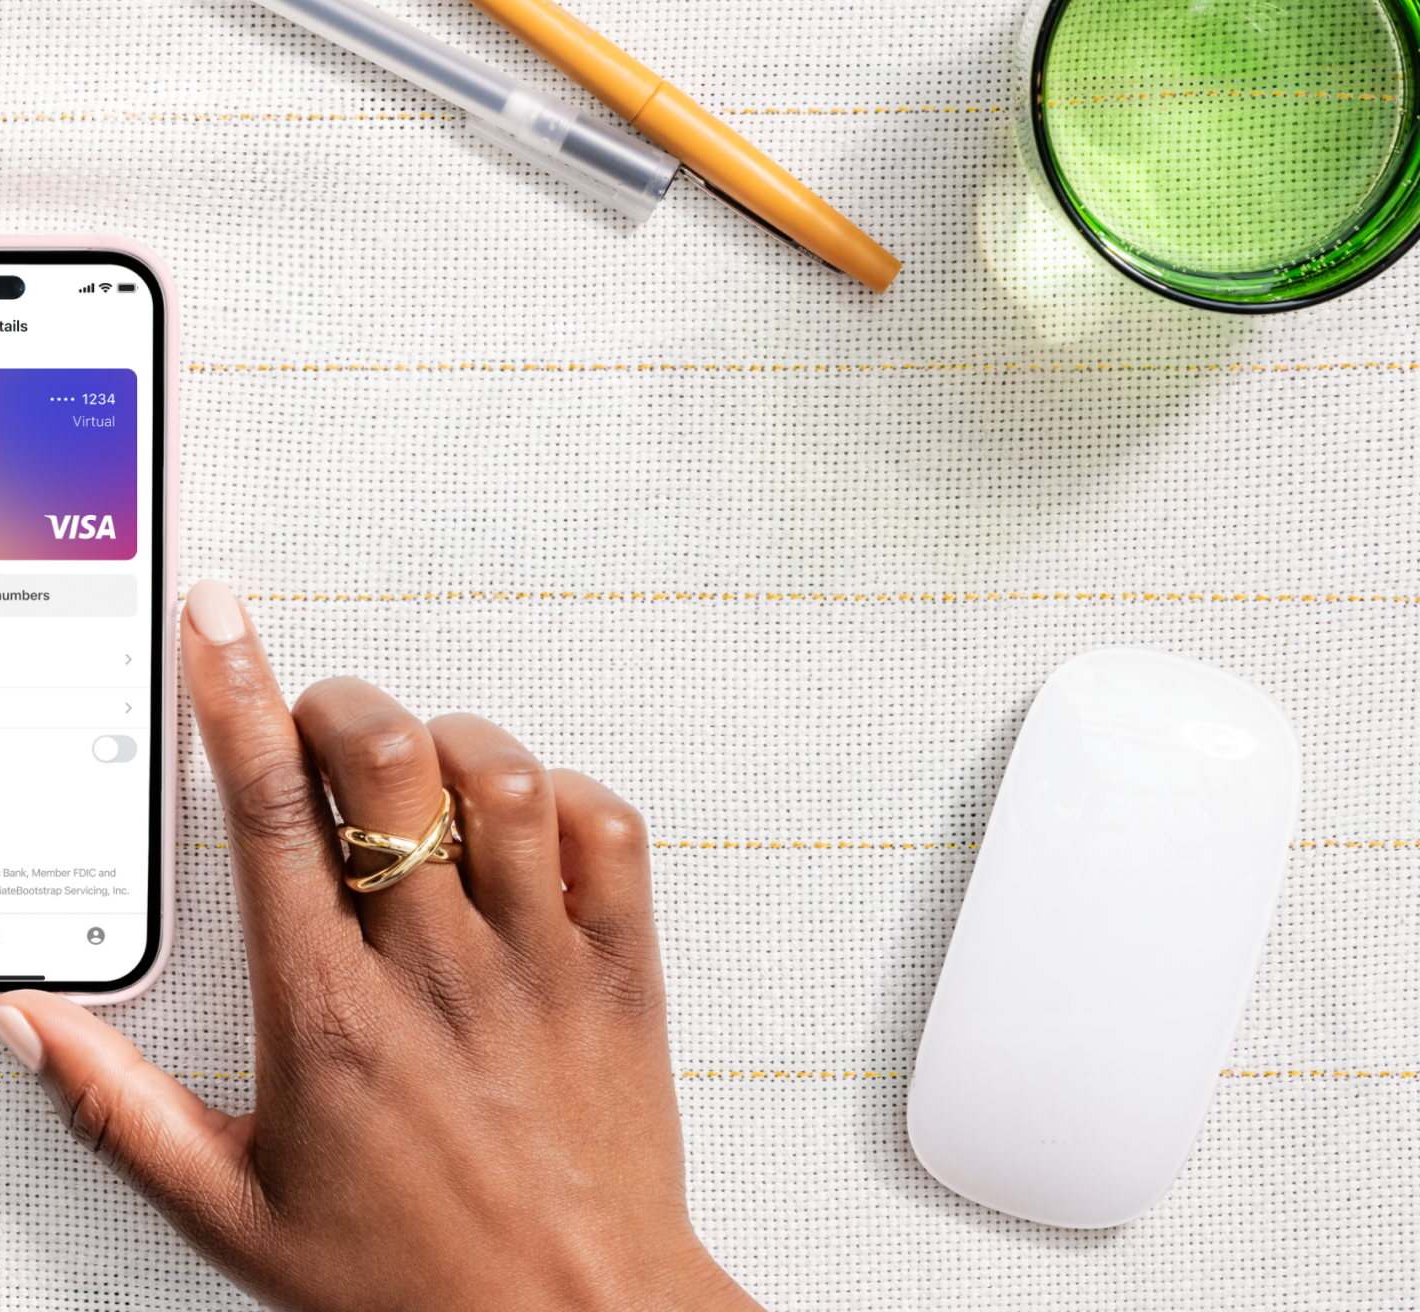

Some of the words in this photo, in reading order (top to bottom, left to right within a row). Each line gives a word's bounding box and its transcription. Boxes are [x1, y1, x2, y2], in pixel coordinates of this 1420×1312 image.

[82, 393, 116, 406] 1234
[72, 415, 115, 428] Virtual
[43, 514, 117, 540] VISA
[2, 868, 29, 879] Bank,
[31, 867, 72, 878] Member
[73, 867, 97, 878] FDIC
[98, 867, 117, 878] and
[64, 885, 110, 898] Servicing,
[112, 886, 130, 896] Inc.
